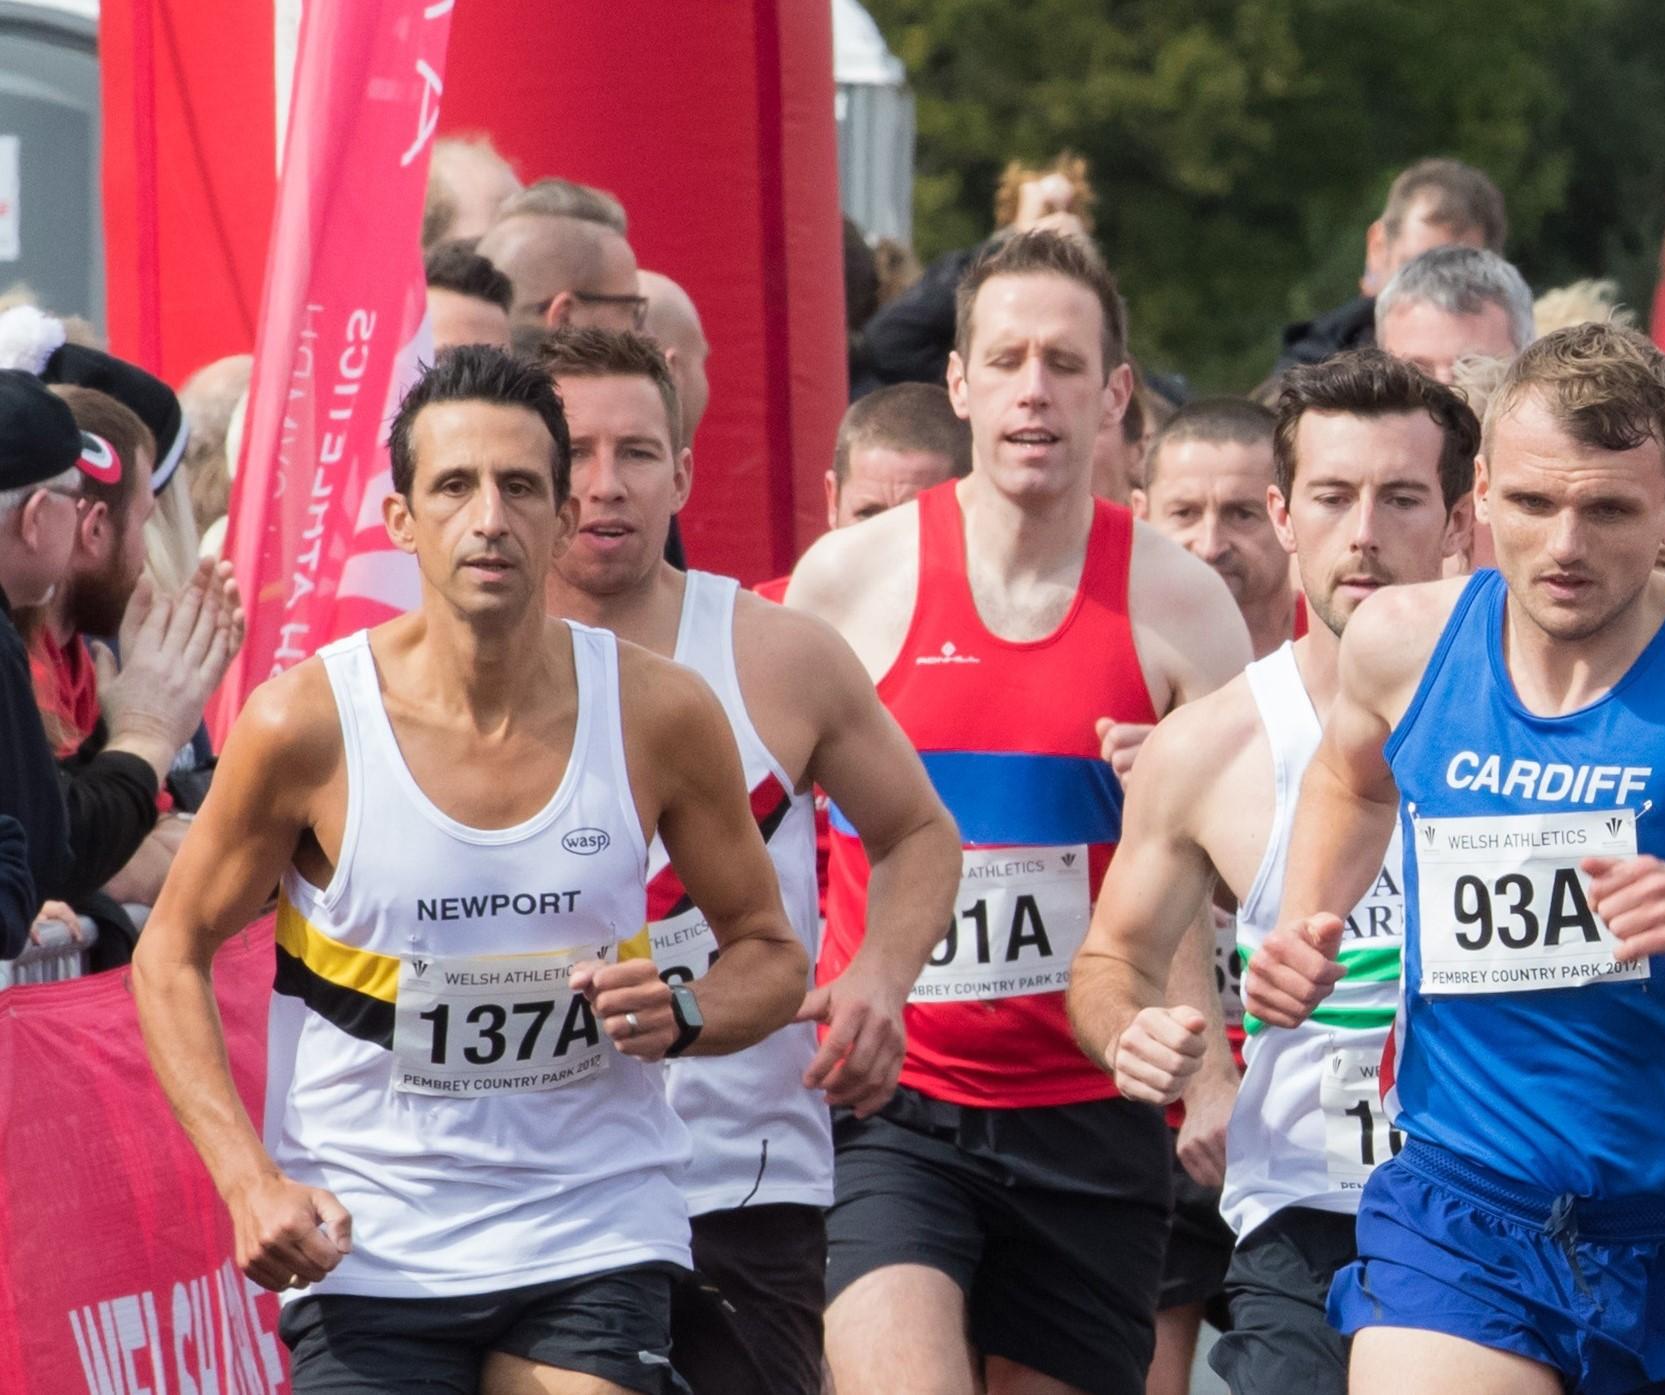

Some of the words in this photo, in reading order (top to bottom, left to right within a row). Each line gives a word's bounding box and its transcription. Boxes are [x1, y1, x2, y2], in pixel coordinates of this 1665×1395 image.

[1446, 751, 1652, 805] CARDIFF
[565, 833, 609, 851] wasp
[1448, 834, 1498, 849] WELSH
[1503, 829, 1587, 849] ATHLETICS
[967, 860, 1045, 879] ATHLETICS
[417, 890, 582, 921] NEWPORT
[1454, 868, 1601, 951] 93A
[446, 970, 500, 985] WELSH
[504, 964, 577, 983] ATHLETIC
[1432, 969, 1487, 984] PEMBREY
[1492, 967, 1557, 982] COUNTRY
[1561, 964, 1600, 978] PARK
[1606, 960, 1637, 975] 2017
[954, 979, 1015, 995] COUNTRY
[1019, 973, 1052, 989] PARK
[420, 993, 599, 1064] 137A
[403, 1074, 470, 1092] PEMBREY
[473, 1075, 538, 1090] COUNTRY
[541, 1069, 575, 1085] PARK
